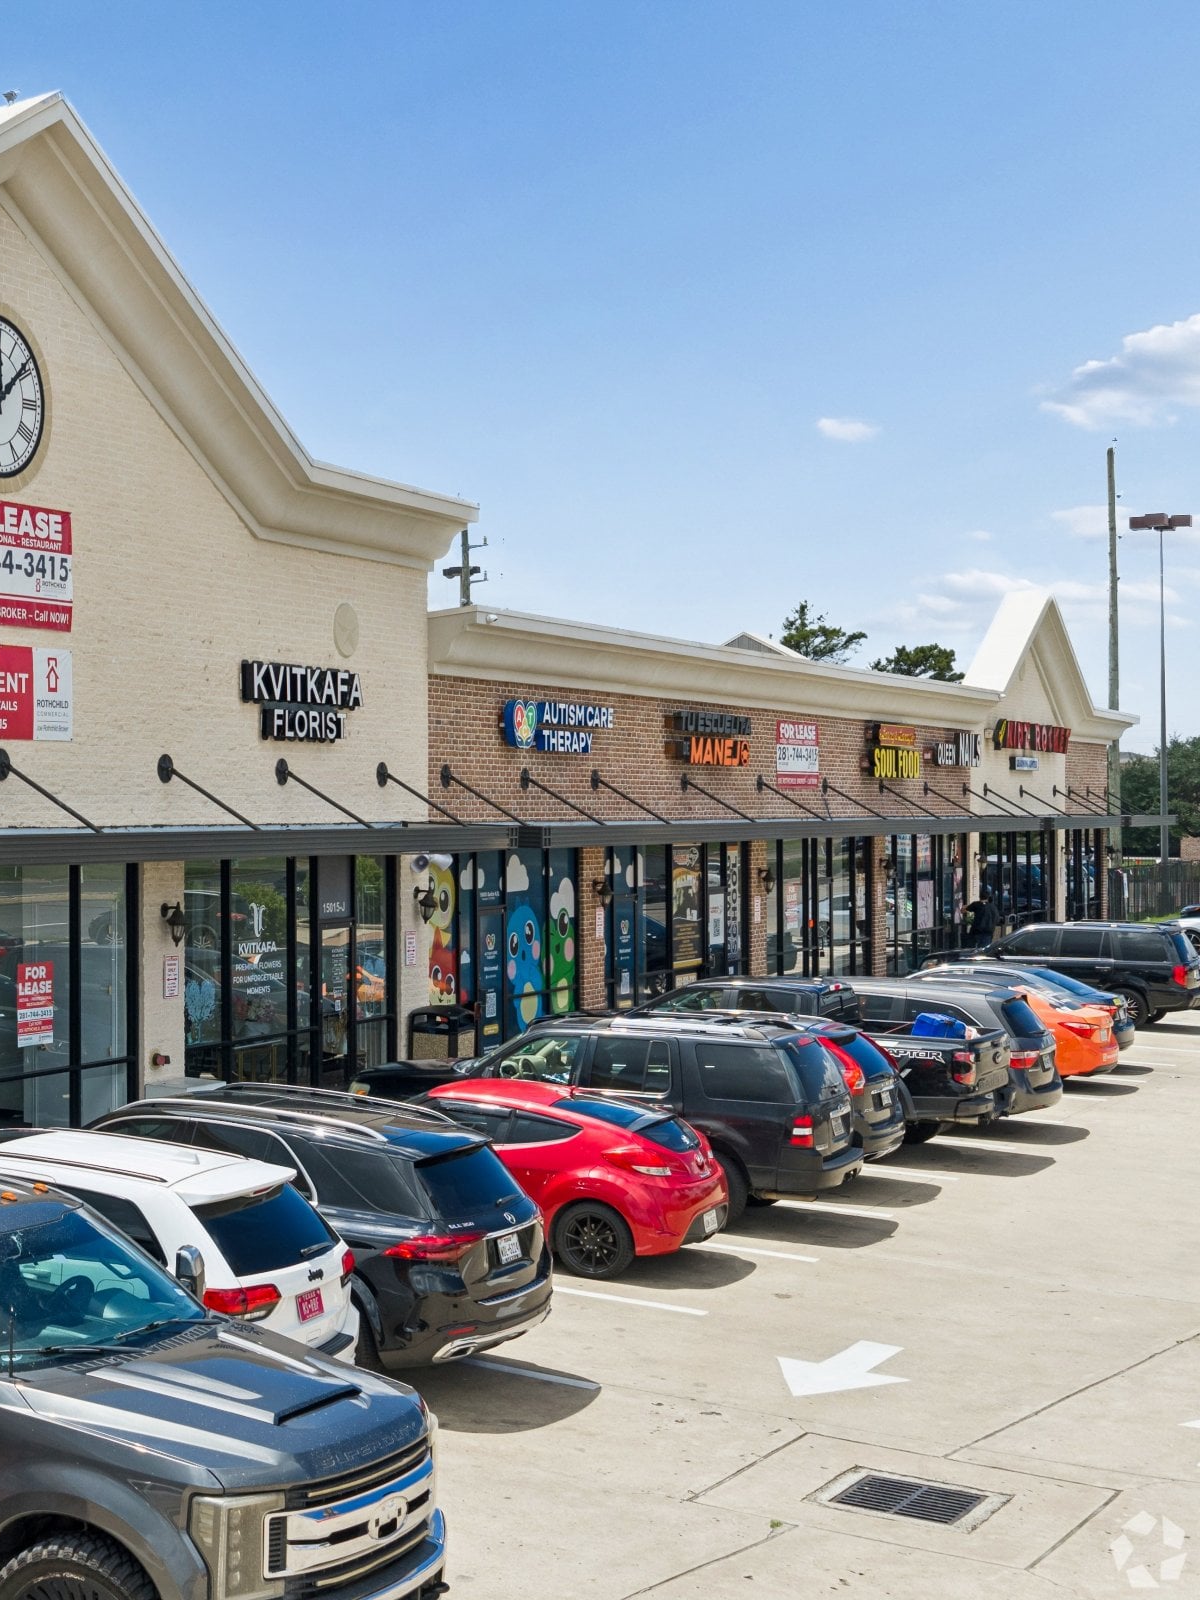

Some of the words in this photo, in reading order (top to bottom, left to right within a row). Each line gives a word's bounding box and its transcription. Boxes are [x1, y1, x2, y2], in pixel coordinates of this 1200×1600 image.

[21, 538, 62, 550] RESTAURANT
[34, 610, 48, 622] Call
[50, 612, 69, 624] NOW!
[253, 662, 363, 707] KVITKAFA
[37, 700, 68, 709] ROTHCHILD
[543, 702, 585, 726] AUTISM
[586, 706, 613, 728] CARE
[681, 711, 696, 731] TU
[698, 711, 751, 735] ESCUELITA
[274, 709, 347, 739] FLORIST
[780, 723, 795, 739] FOR
[795, 724, 816, 740] LEASE
[543, 730, 592, 753] THERAPY
[959, 732, 981, 767] NAILS
[938, 743, 956, 765] QUEEN
[874, 748, 897, 778] SOUL
[898, 749, 920, 778] FOOD
[323, 901, 345, 913] 15015-J
[238, 941, 277, 955] KVITKAFA
[25, 965, 46, 980] FOR
[259, 960, 282, 969] FLOWERS
[233, 976, 244, 984] FOR
[244, 972, 284, 983] UNFORGETTABLE
[18, 980, 52, 996] LEASE
[247, 986, 271, 995] MOMENTS
